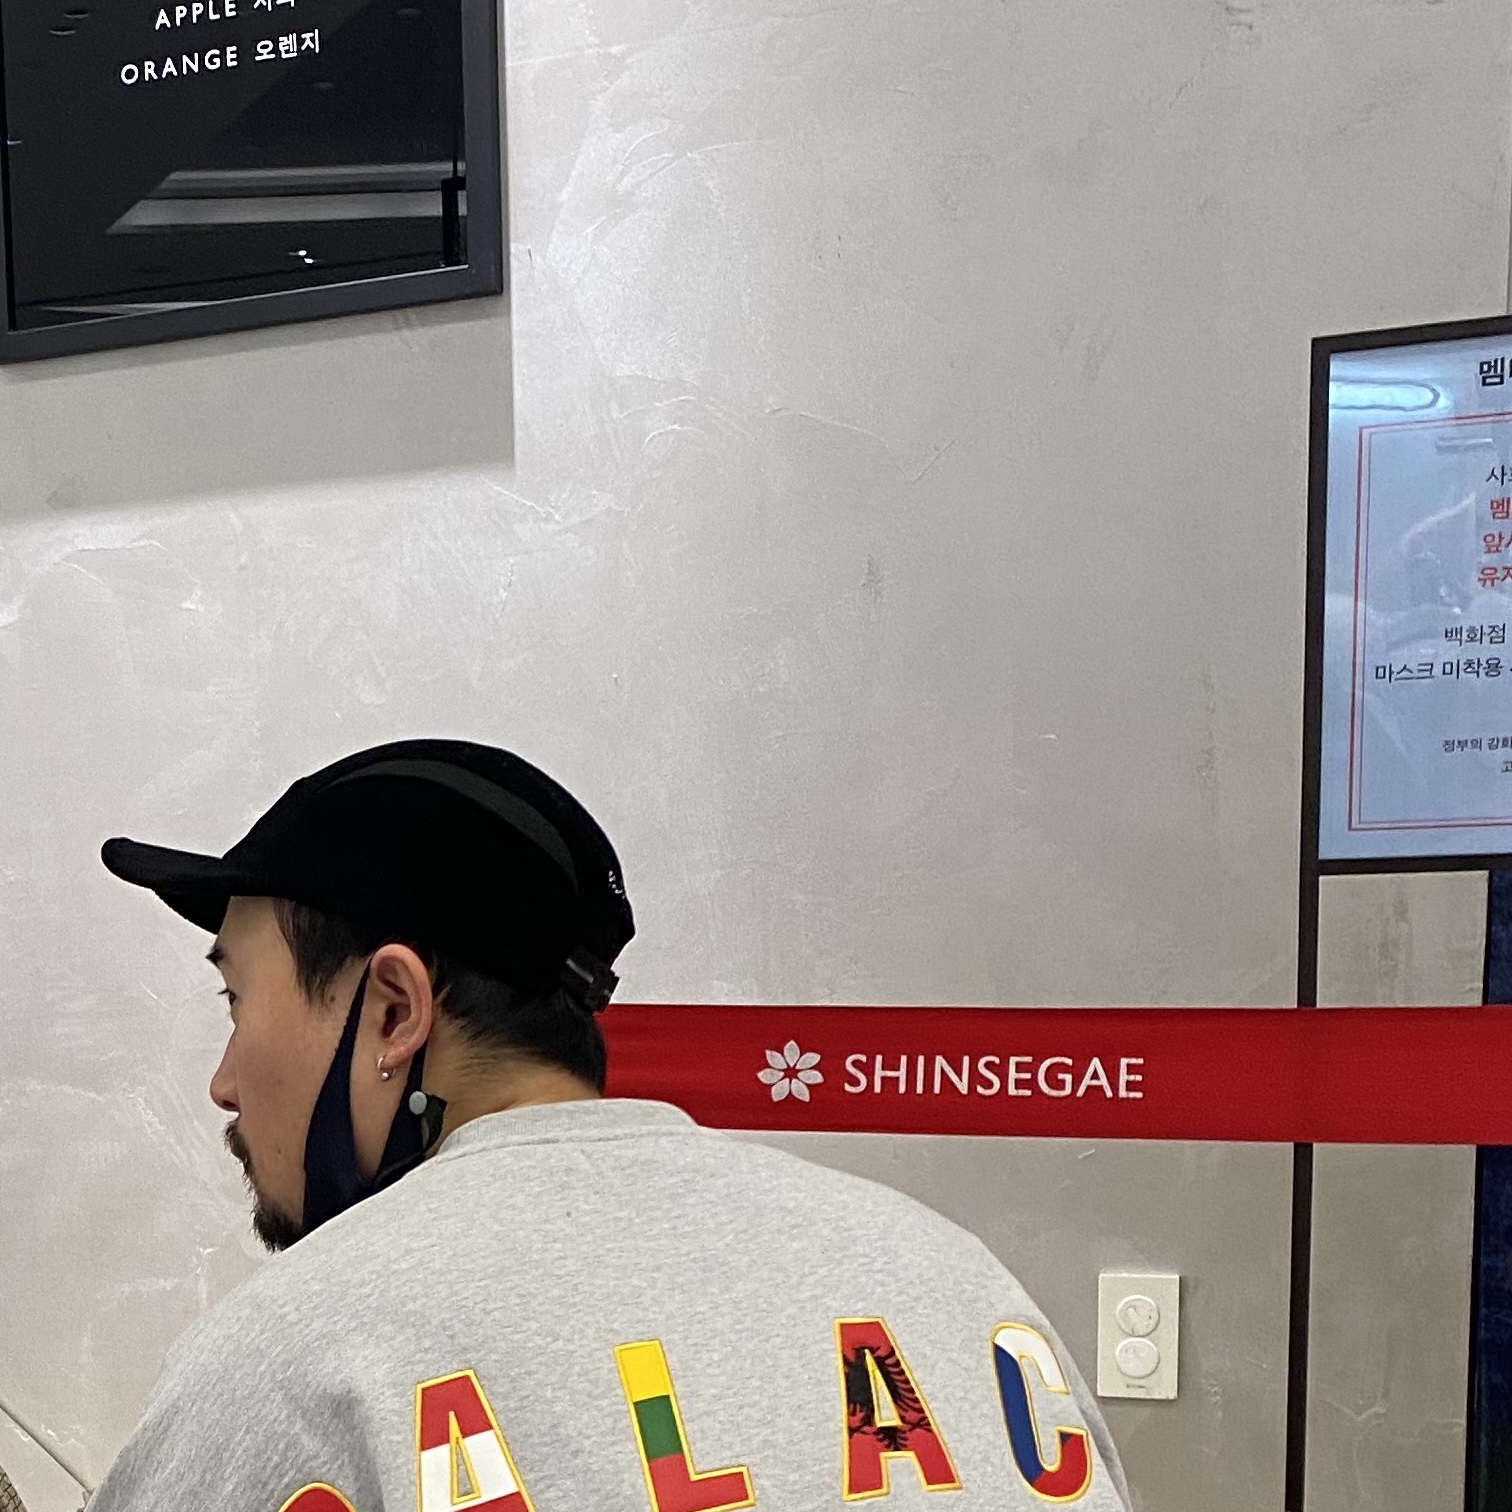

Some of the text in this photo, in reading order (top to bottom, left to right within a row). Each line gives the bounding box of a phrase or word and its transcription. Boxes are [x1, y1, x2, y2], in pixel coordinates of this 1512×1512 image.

[154, 0, 237, 30] APPLE
[120, 28, 320, 85] ORANGE 오렌지
[1479, 357, 1512, 387] 멤
[1485, 464, 1512, 486] 사
[1482, 531, 1512, 555] 앞
[1444, 622, 1507, 647] 백화점
[1374, 656, 1504, 684] 마스크 미착용
[843, 1053, 1145, 1099] SHINSEGAE
